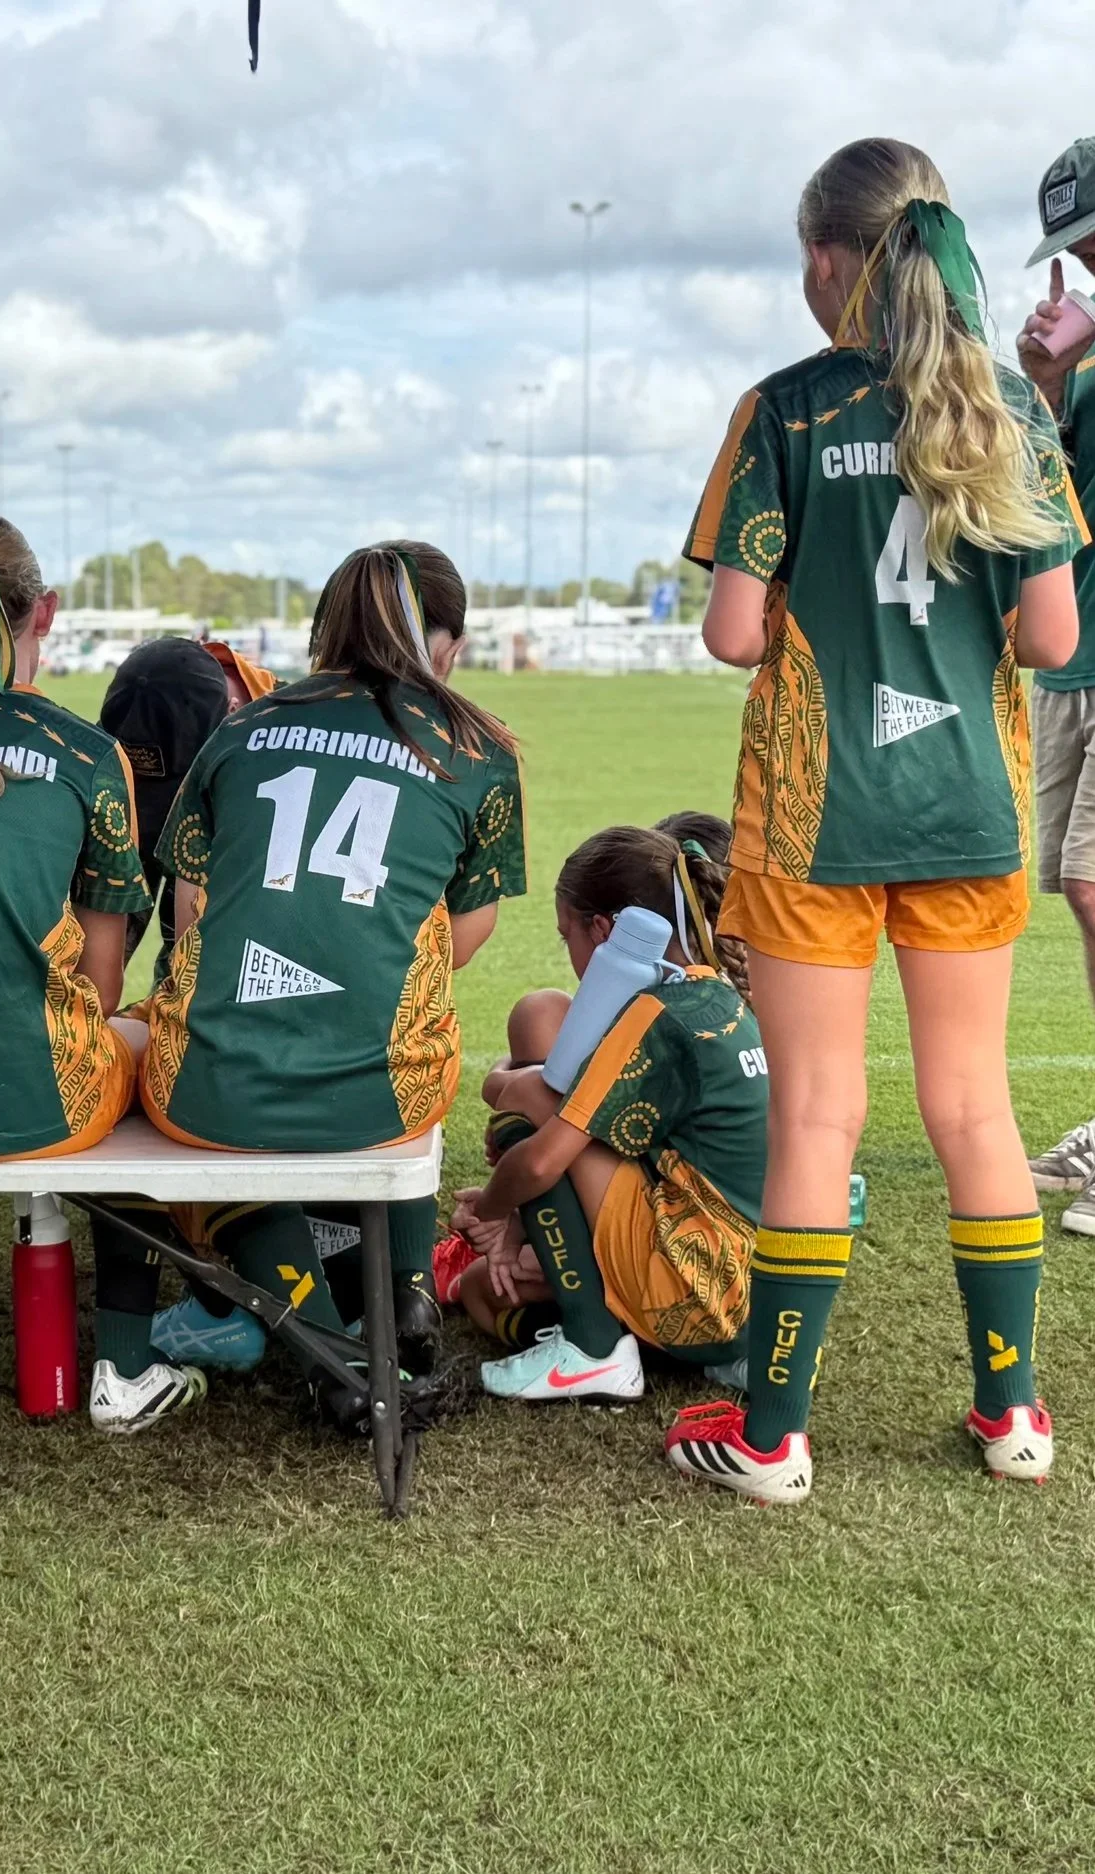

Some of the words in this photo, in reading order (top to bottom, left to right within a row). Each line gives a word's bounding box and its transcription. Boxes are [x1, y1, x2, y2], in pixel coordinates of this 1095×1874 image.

[875, 495, 936, 626] 4
[881, 691, 943, 714] BETWEEN
[881, 719, 905, 739] THE
[256, 765, 401, 908] 14
[247, 977, 273, 997] THE
[279, 980, 321, 995] FLAGS
[250, 948, 322, 986] BETWEEN
[536, 1208, 583, 1290] CUFC
[767, 1309, 804, 1385] CUFC
